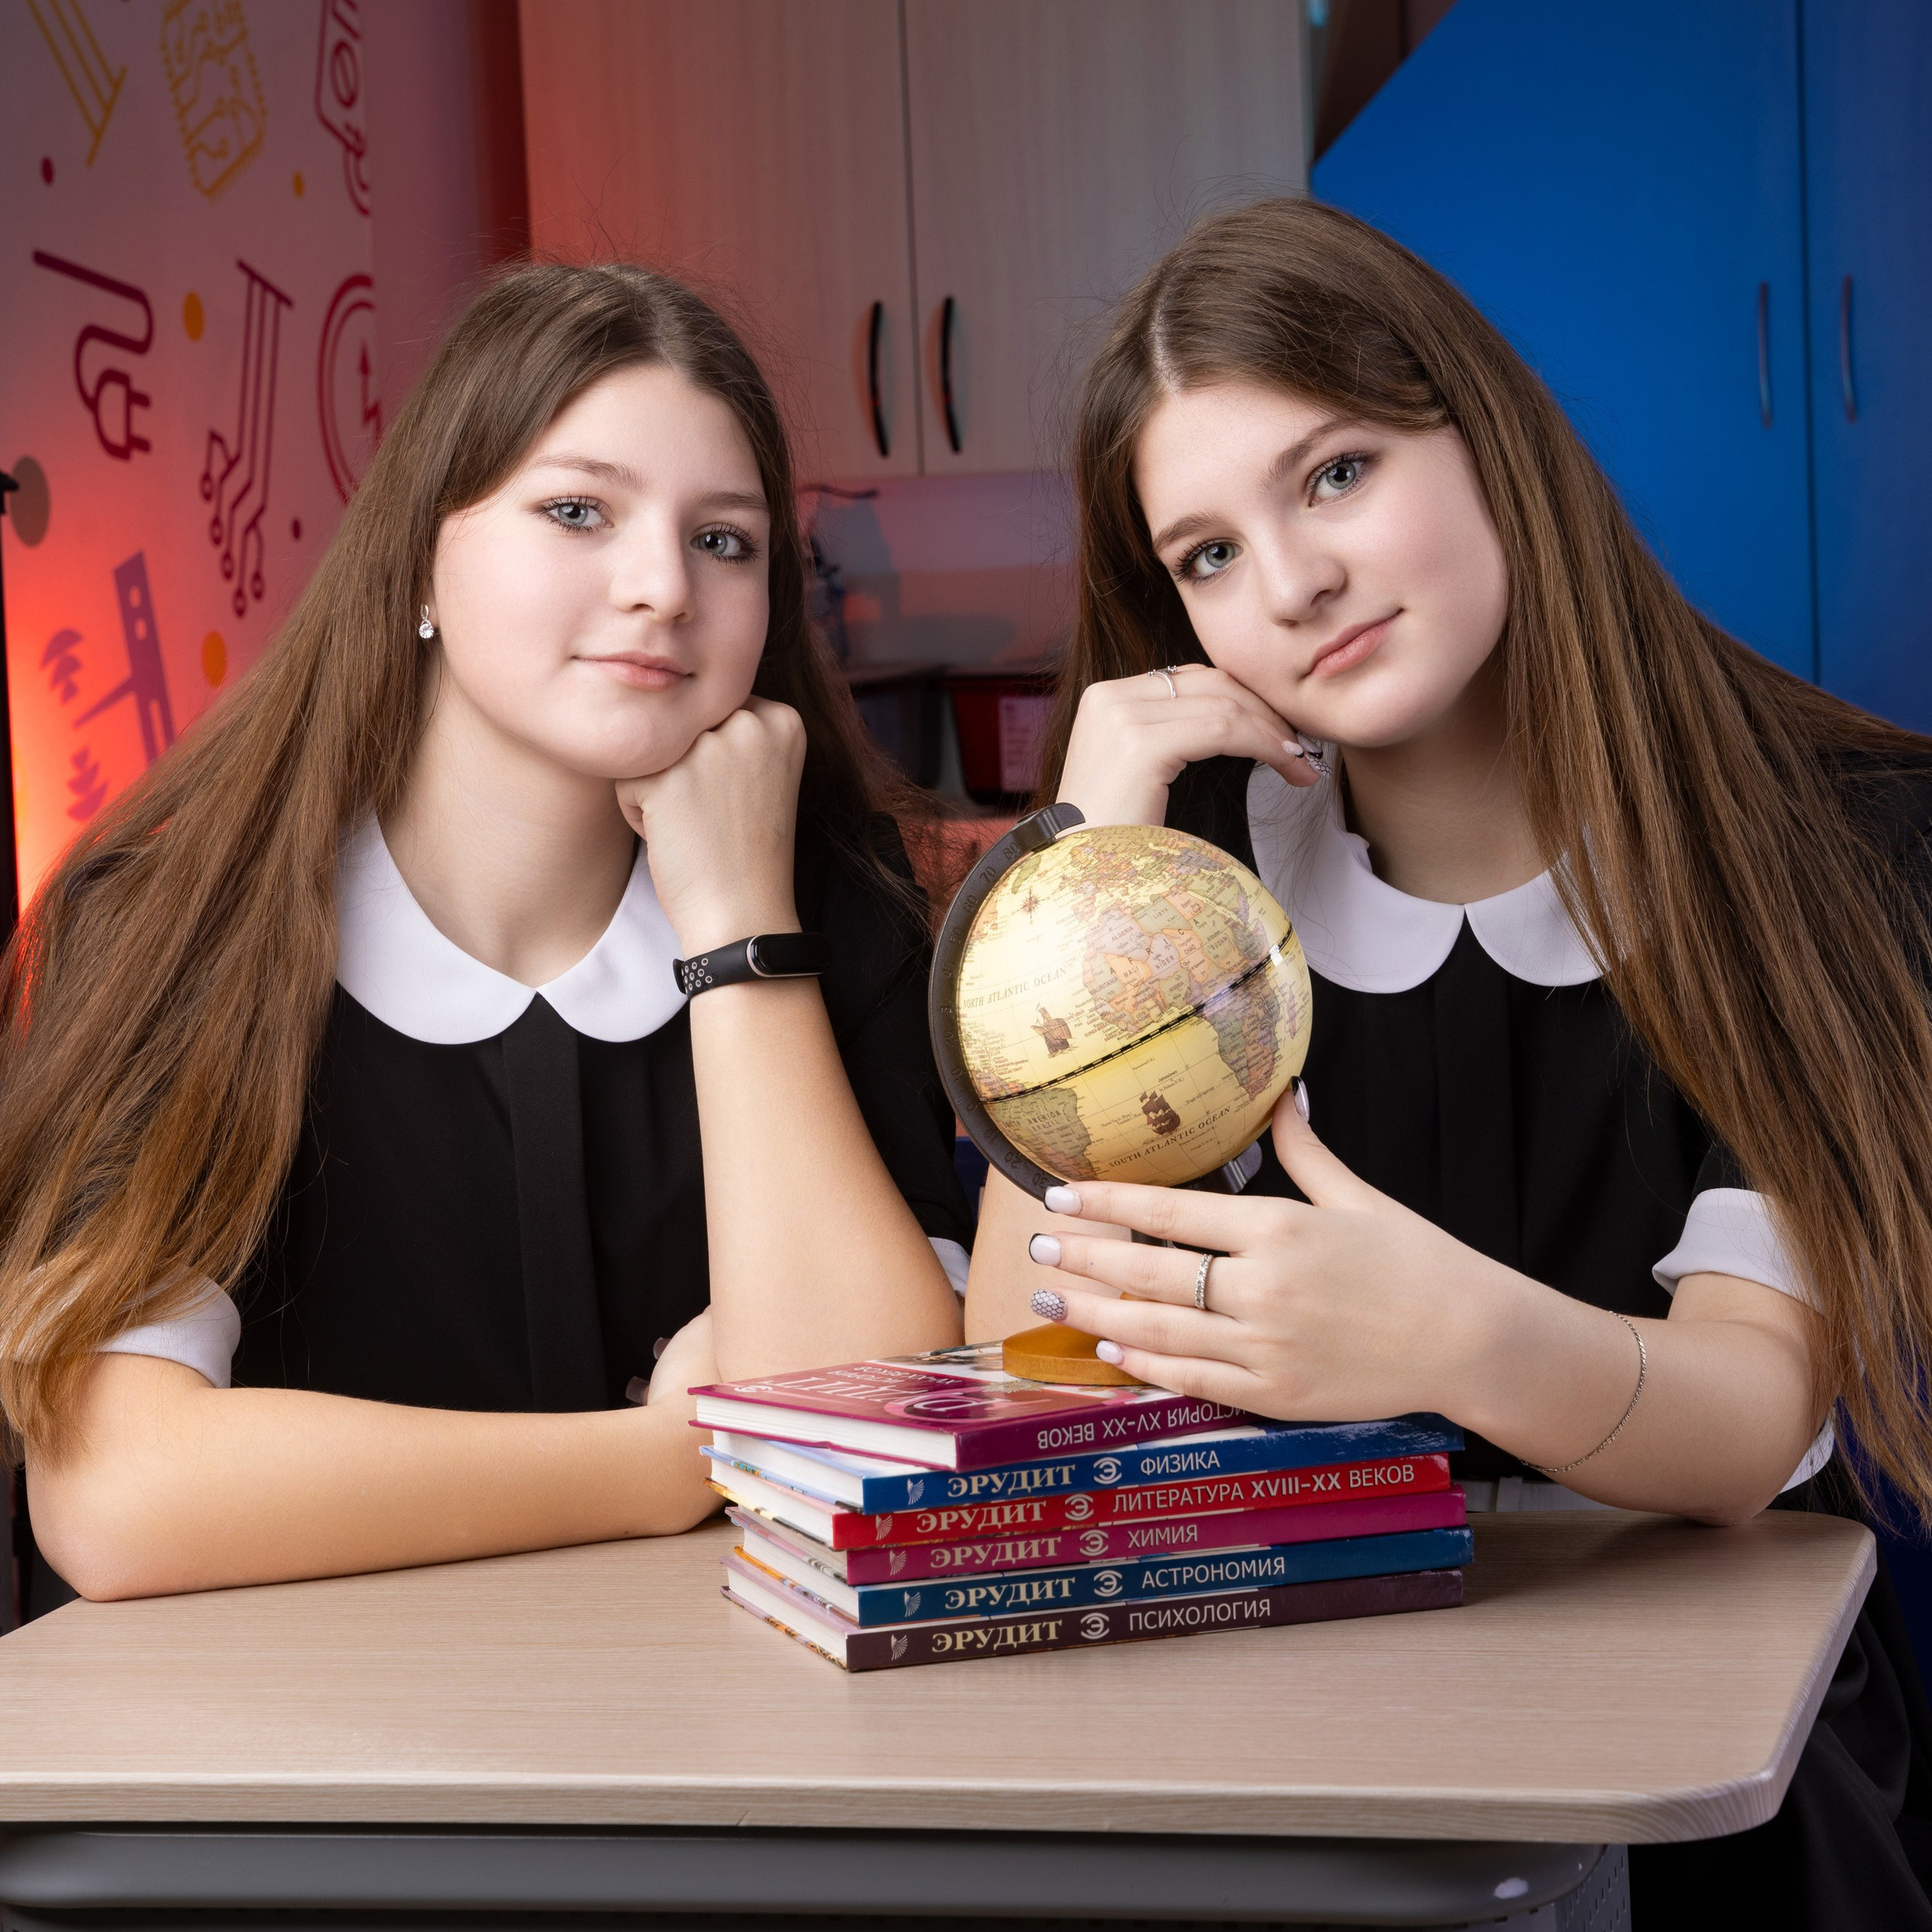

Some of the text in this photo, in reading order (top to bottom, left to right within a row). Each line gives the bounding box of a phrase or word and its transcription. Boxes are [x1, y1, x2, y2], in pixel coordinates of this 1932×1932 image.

[1003, 841, 1020, 860] 80
[980, 866, 996, 883] 70
[962, 894, 977, 912] 60
[1152, 908, 1168, 919] LIBYA
[1111, 925, 1134, 941] ALGERIA
[1183, 944, 1196, 955] CHAD
[1211, 937, 1228, 950] SUDAN
[1123, 965, 1140, 978] MALI
[1155, 955, 1175, 971] NIGER
[963, 966, 1066, 1009] NORTH ATLANTIC OCEAN
[1091, 976, 1118, 995] MAURITANIA
[1169, 981, 1184, 992] NIGERIA
[1158, 1070, 1177, 1082] Jamestown
[1028, 1110, 1062, 1125] AMERICA
[1032, 1120, 1060, 1132] BRAZIL
[1109, 1152, 1142, 1168] SOUTH
[1144, 1128, 1195, 1156] ATLANTIC
[1198, 1106, 1231, 1130] OCEAN
[1004, 1151, 1022, 1168] 20
[1103, 1412, 1161, 1438] XV-XX
[1038, 1422, 1094, 1450] ВЕКОВ
[948, 1464, 1075, 1497] ЭРУДИТ
[1140, 1451, 1220, 1475] ФИЗИКА
[916, 1500, 1047, 1533] ЭРУДИТ
[1113, 1482, 1244, 1512] ЛИТЕРАТУРА
[1251, 1472, 1341, 1498] XVIII-XX
[1349, 1465, 1415, 1487] ВЕКОВ
[930, 1537, 1061, 1568] ЭРУДИТ
[1128, 1524, 1198, 1548] ХИМИЯ
[945, 1577, 1075, 1610] ЭРУДИТ
[1142, 1557, 1285, 1589] АСТРОНОМИЯ
[932, 1620, 1062, 1652] ЭРУДИТ
[1130, 1599, 1271, 1631] ПСИХОЛОГИЯ
